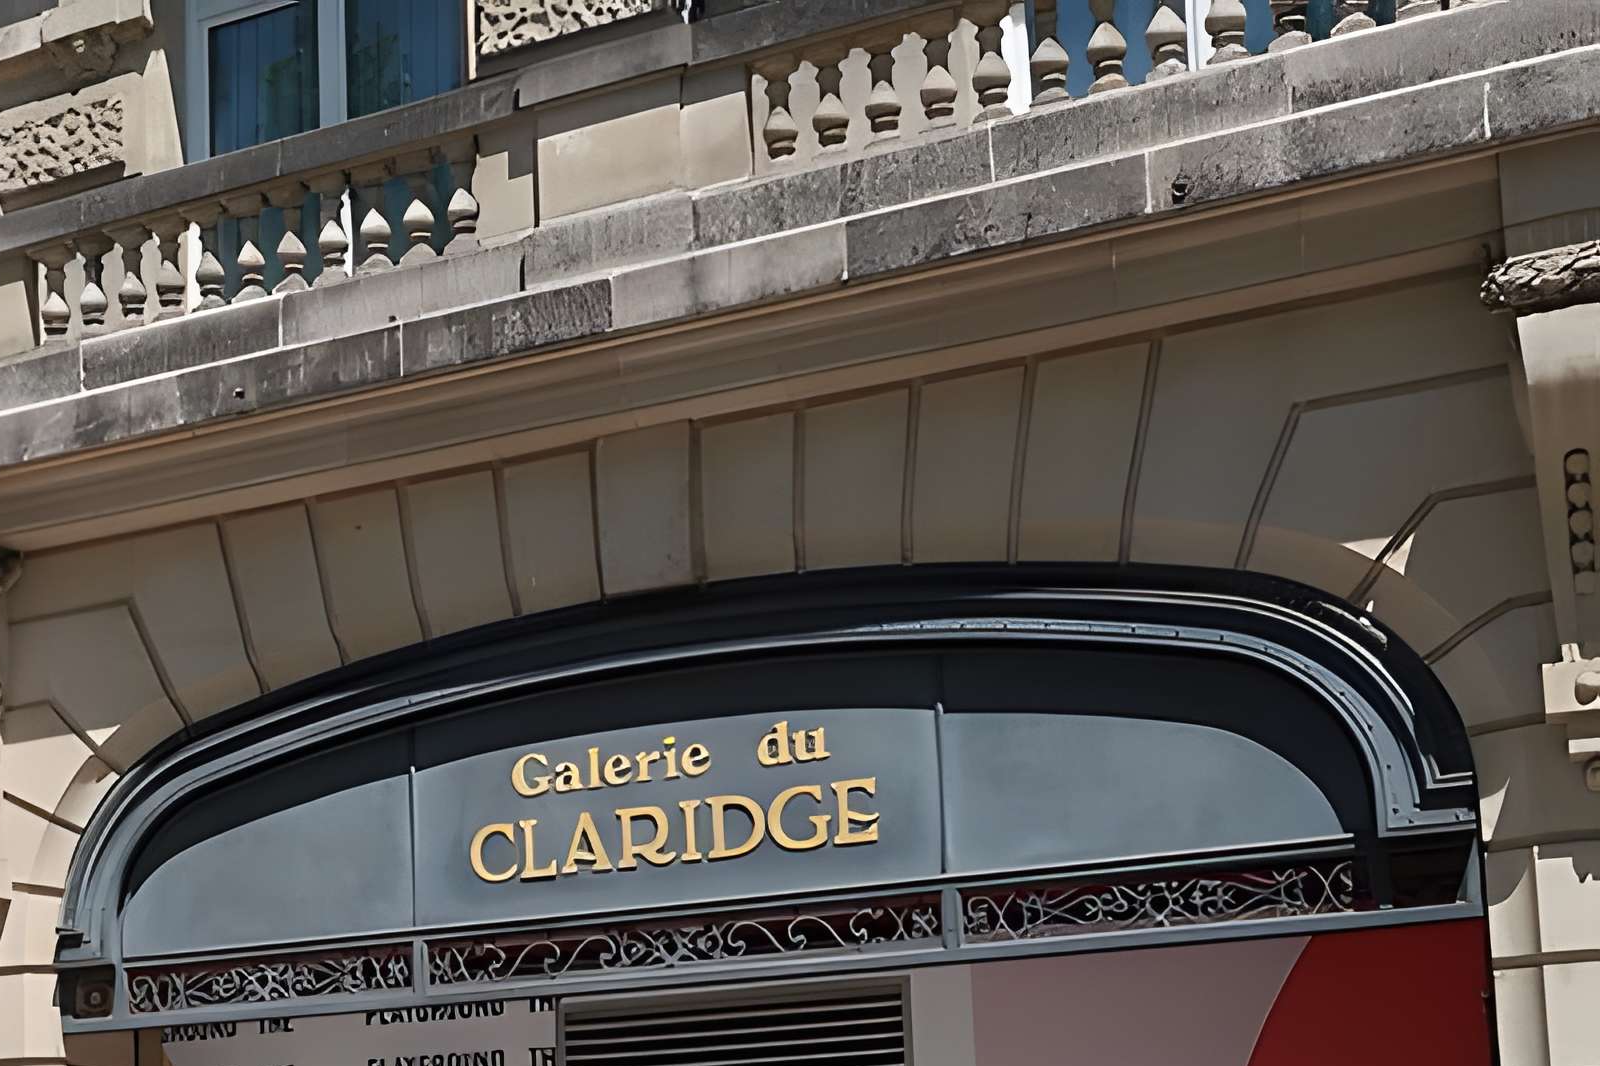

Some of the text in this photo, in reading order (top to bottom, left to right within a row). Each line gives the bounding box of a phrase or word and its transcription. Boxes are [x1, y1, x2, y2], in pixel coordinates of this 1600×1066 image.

[510, 720, 831, 797] Galerie du
[470, 777, 880, 883] CLARIDGE
